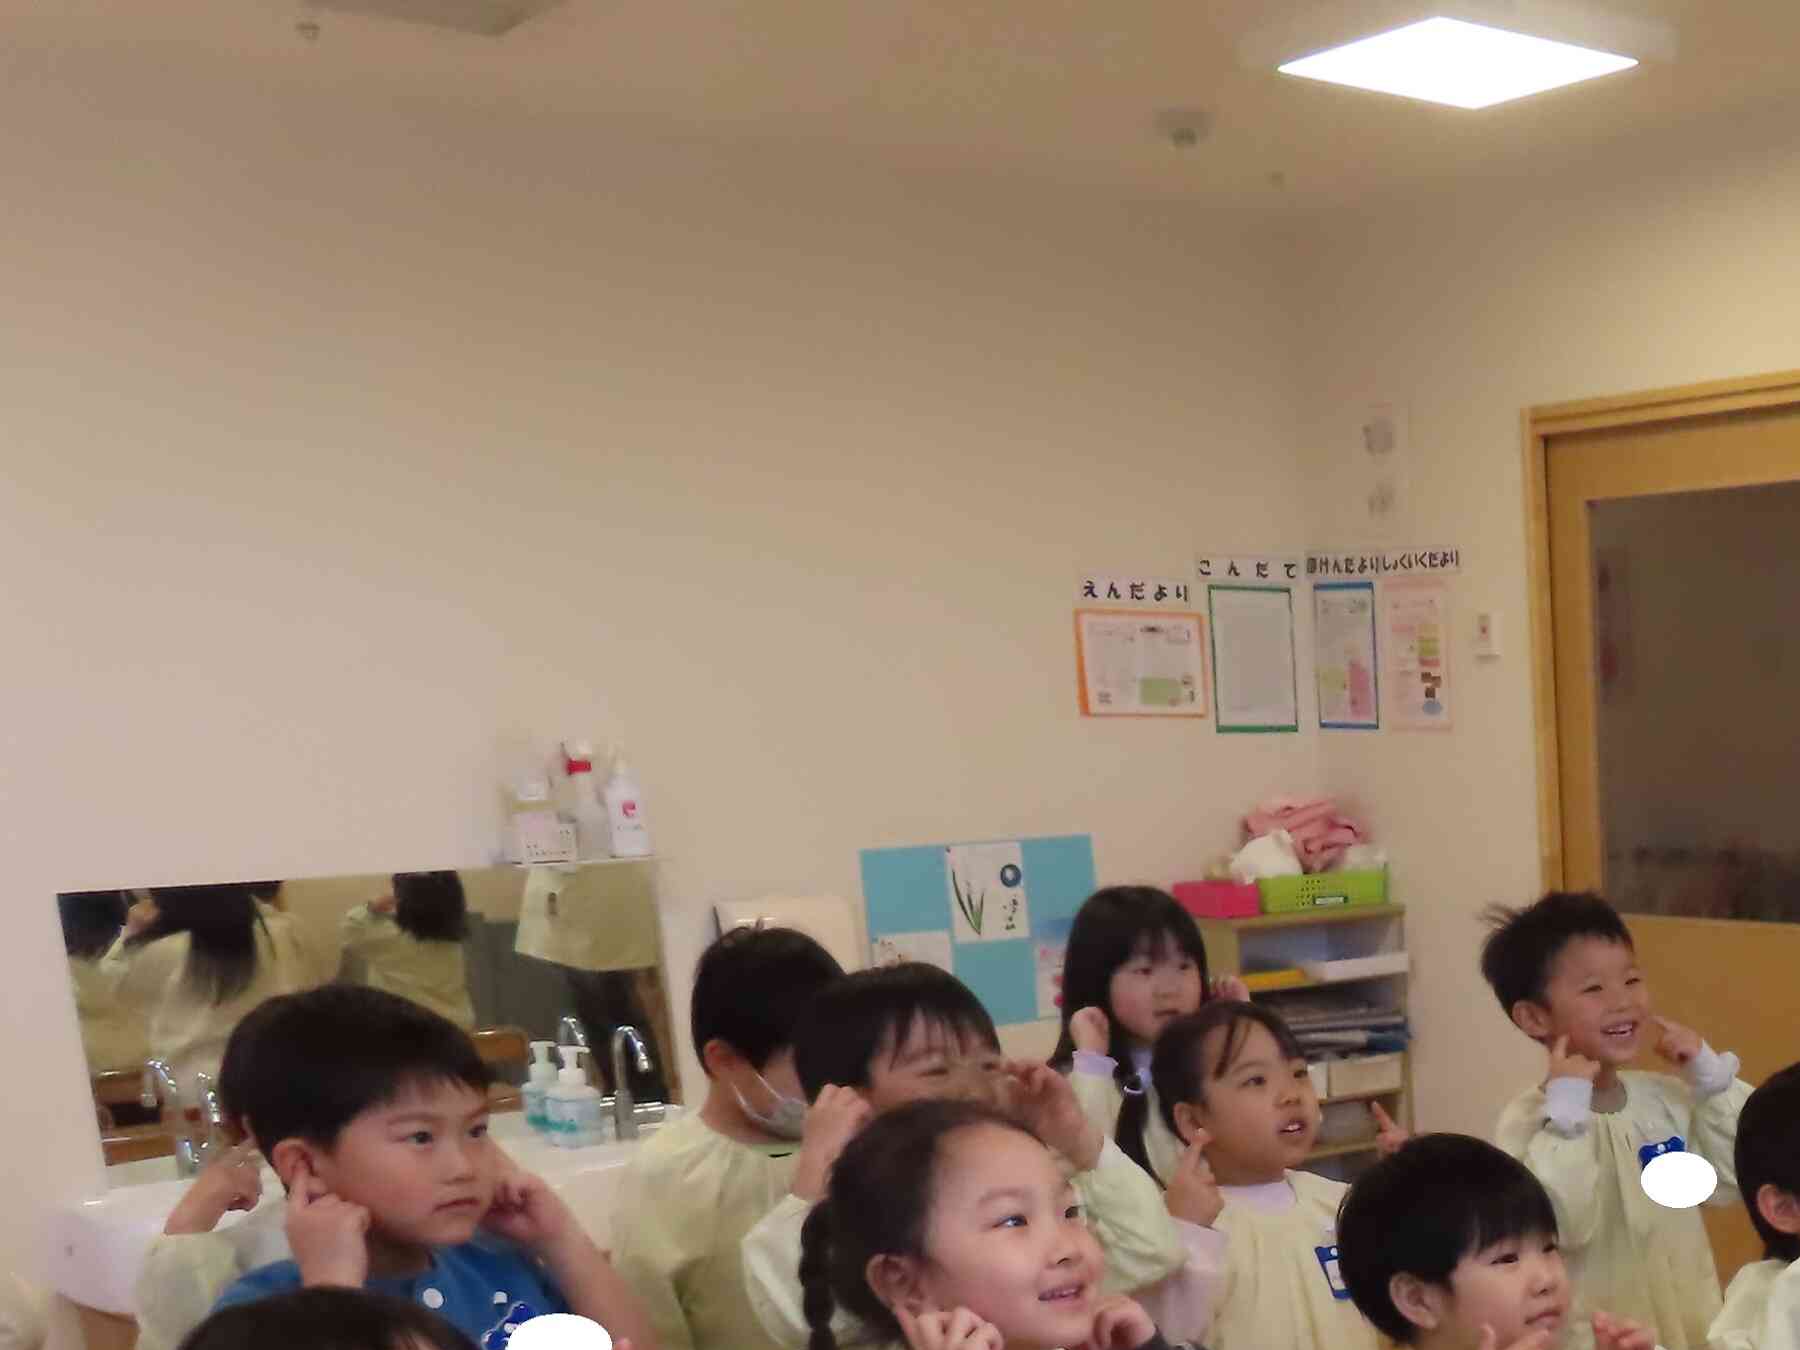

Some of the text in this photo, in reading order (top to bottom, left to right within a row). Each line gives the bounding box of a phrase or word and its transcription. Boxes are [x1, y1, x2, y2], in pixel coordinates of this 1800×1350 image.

[1199, 559, 1297, 579] こんだて
[1083, 580, 1188, 602] えんだより
